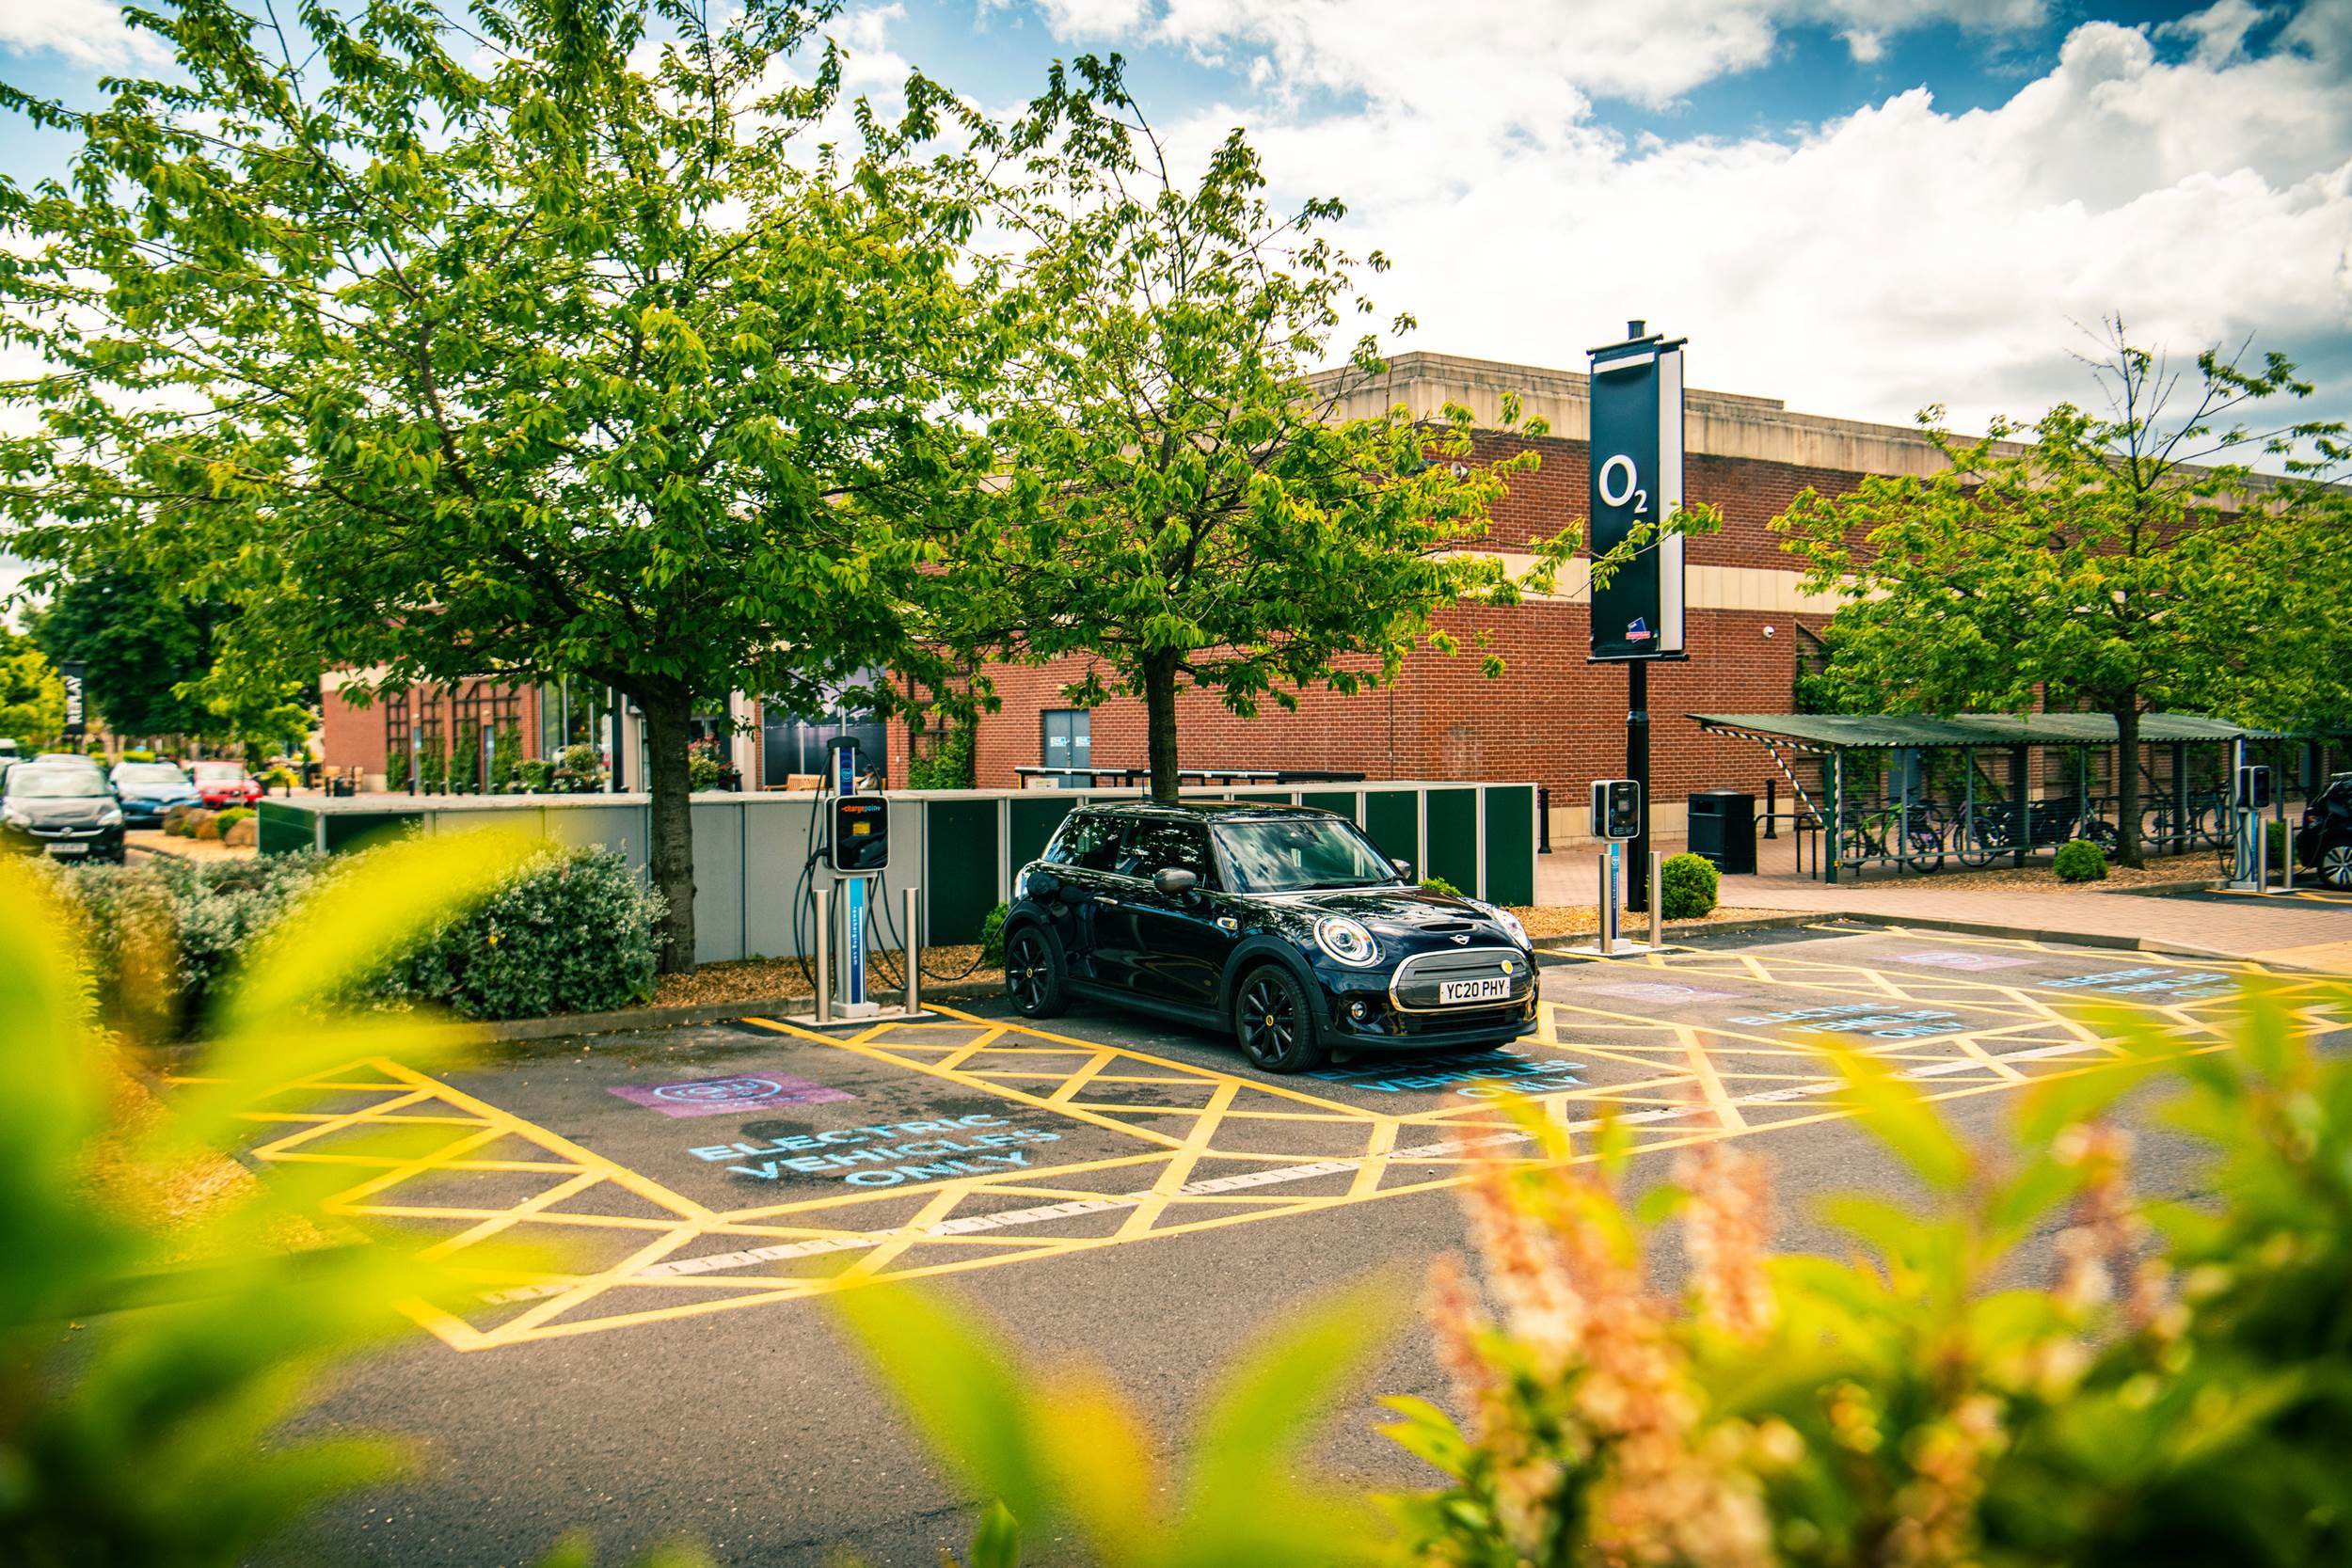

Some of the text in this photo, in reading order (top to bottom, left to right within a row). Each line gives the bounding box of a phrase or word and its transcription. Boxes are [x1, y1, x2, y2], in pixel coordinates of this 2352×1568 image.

[1598, 454, 1648, 514] O2
[1447, 979, 1505, 999] YC20 PHY
[1352, 1059, 1588, 1093] VEHICLES
[688, 1114, 1009, 1162] ELECTRIC
[725, 1129, 1062, 1180] VEHICLES
[845, 1150, 1032, 1187] ONLY
